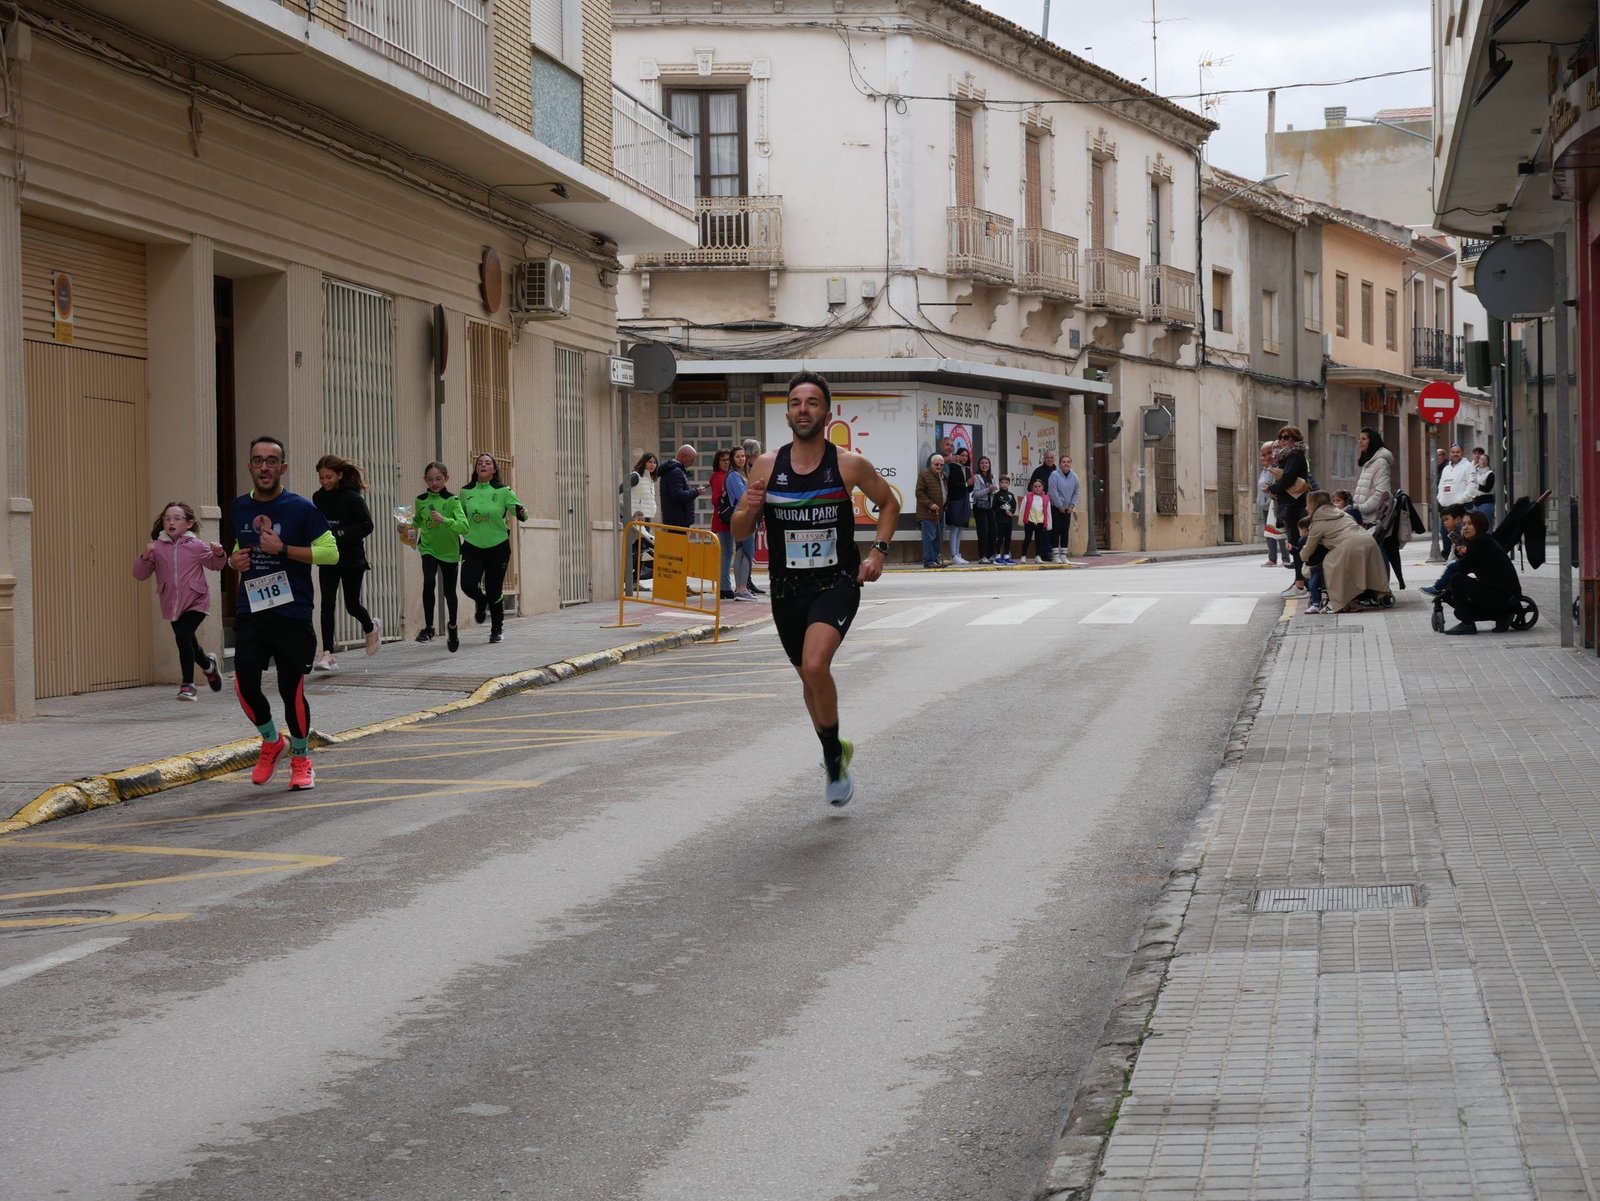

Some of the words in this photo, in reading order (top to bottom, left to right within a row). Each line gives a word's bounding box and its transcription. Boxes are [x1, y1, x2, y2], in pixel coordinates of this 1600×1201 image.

[973, 404, 980, 419] 17
[812, 505, 839, 521] PARK
[802, 543, 822, 557] 12
[257, 584, 281, 600] 118
